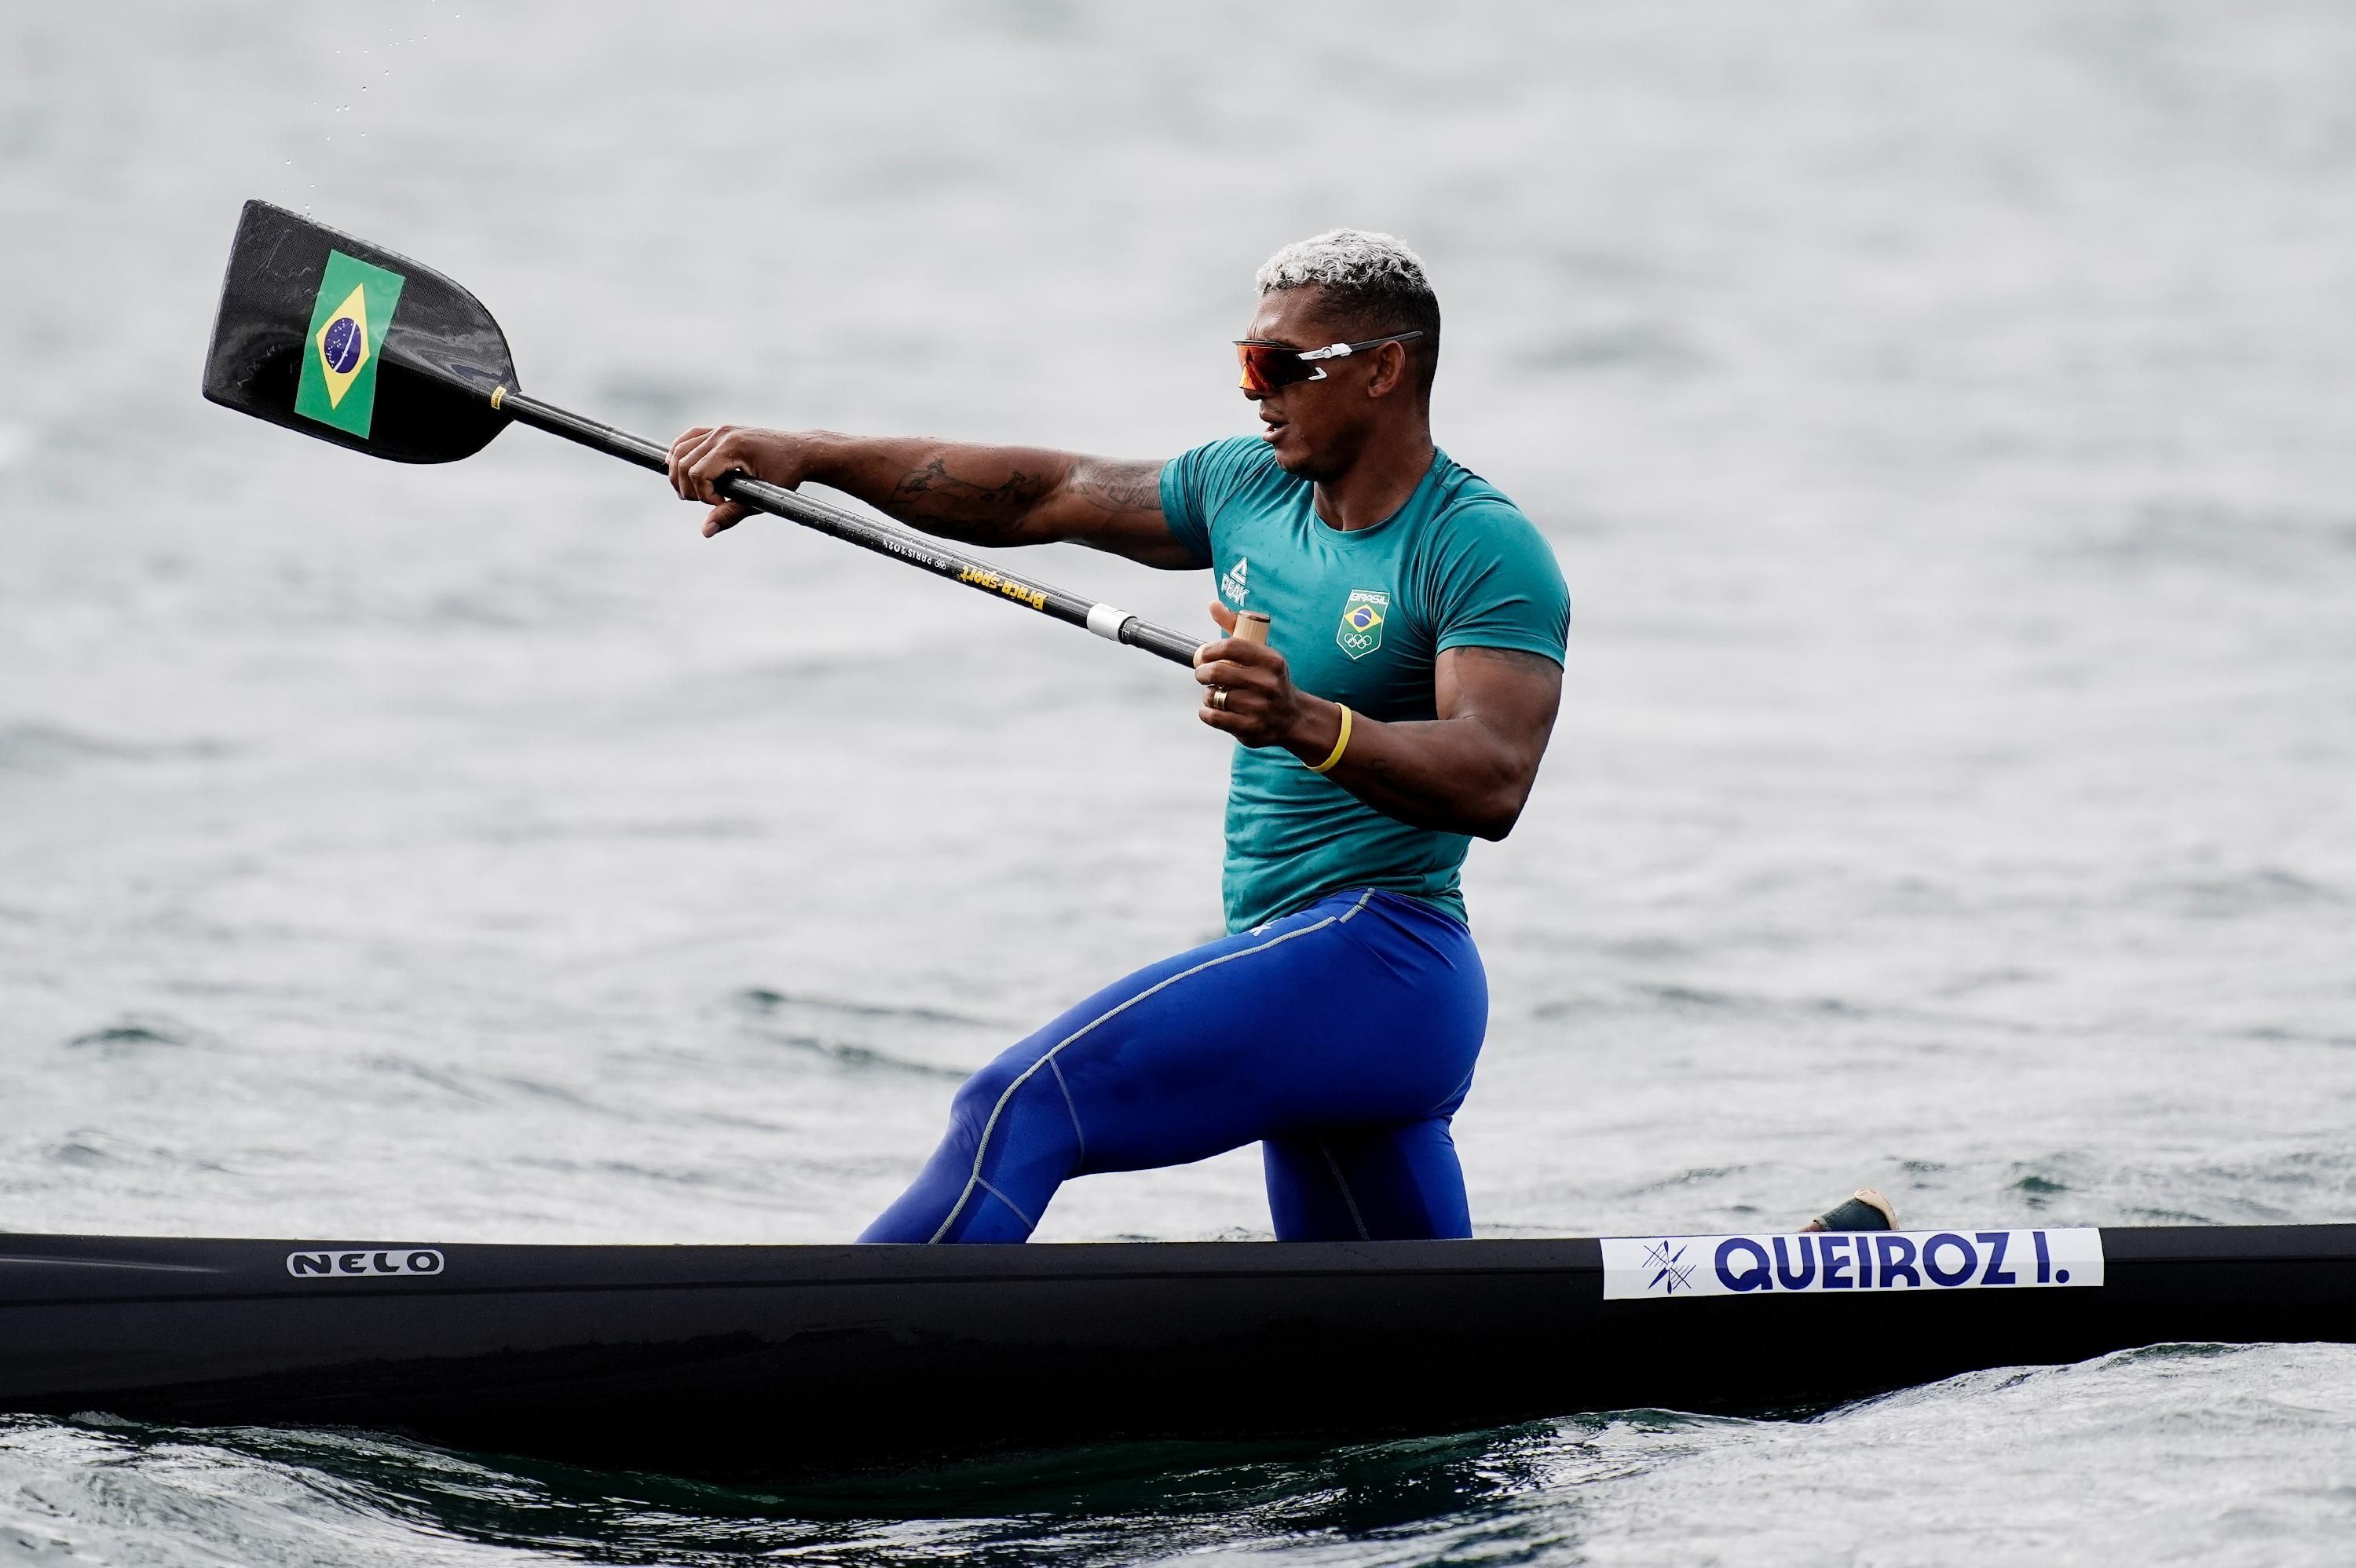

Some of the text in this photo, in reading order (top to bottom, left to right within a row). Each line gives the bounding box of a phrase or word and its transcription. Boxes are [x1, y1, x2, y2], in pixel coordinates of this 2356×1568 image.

[1221, 573, 1249, 607] PEAK
[1350, 592, 1388, 605] BRASIL
[293, 1252, 440, 1274] NELO
[1714, 1231, 2071, 1291] QUEIROZ I.
